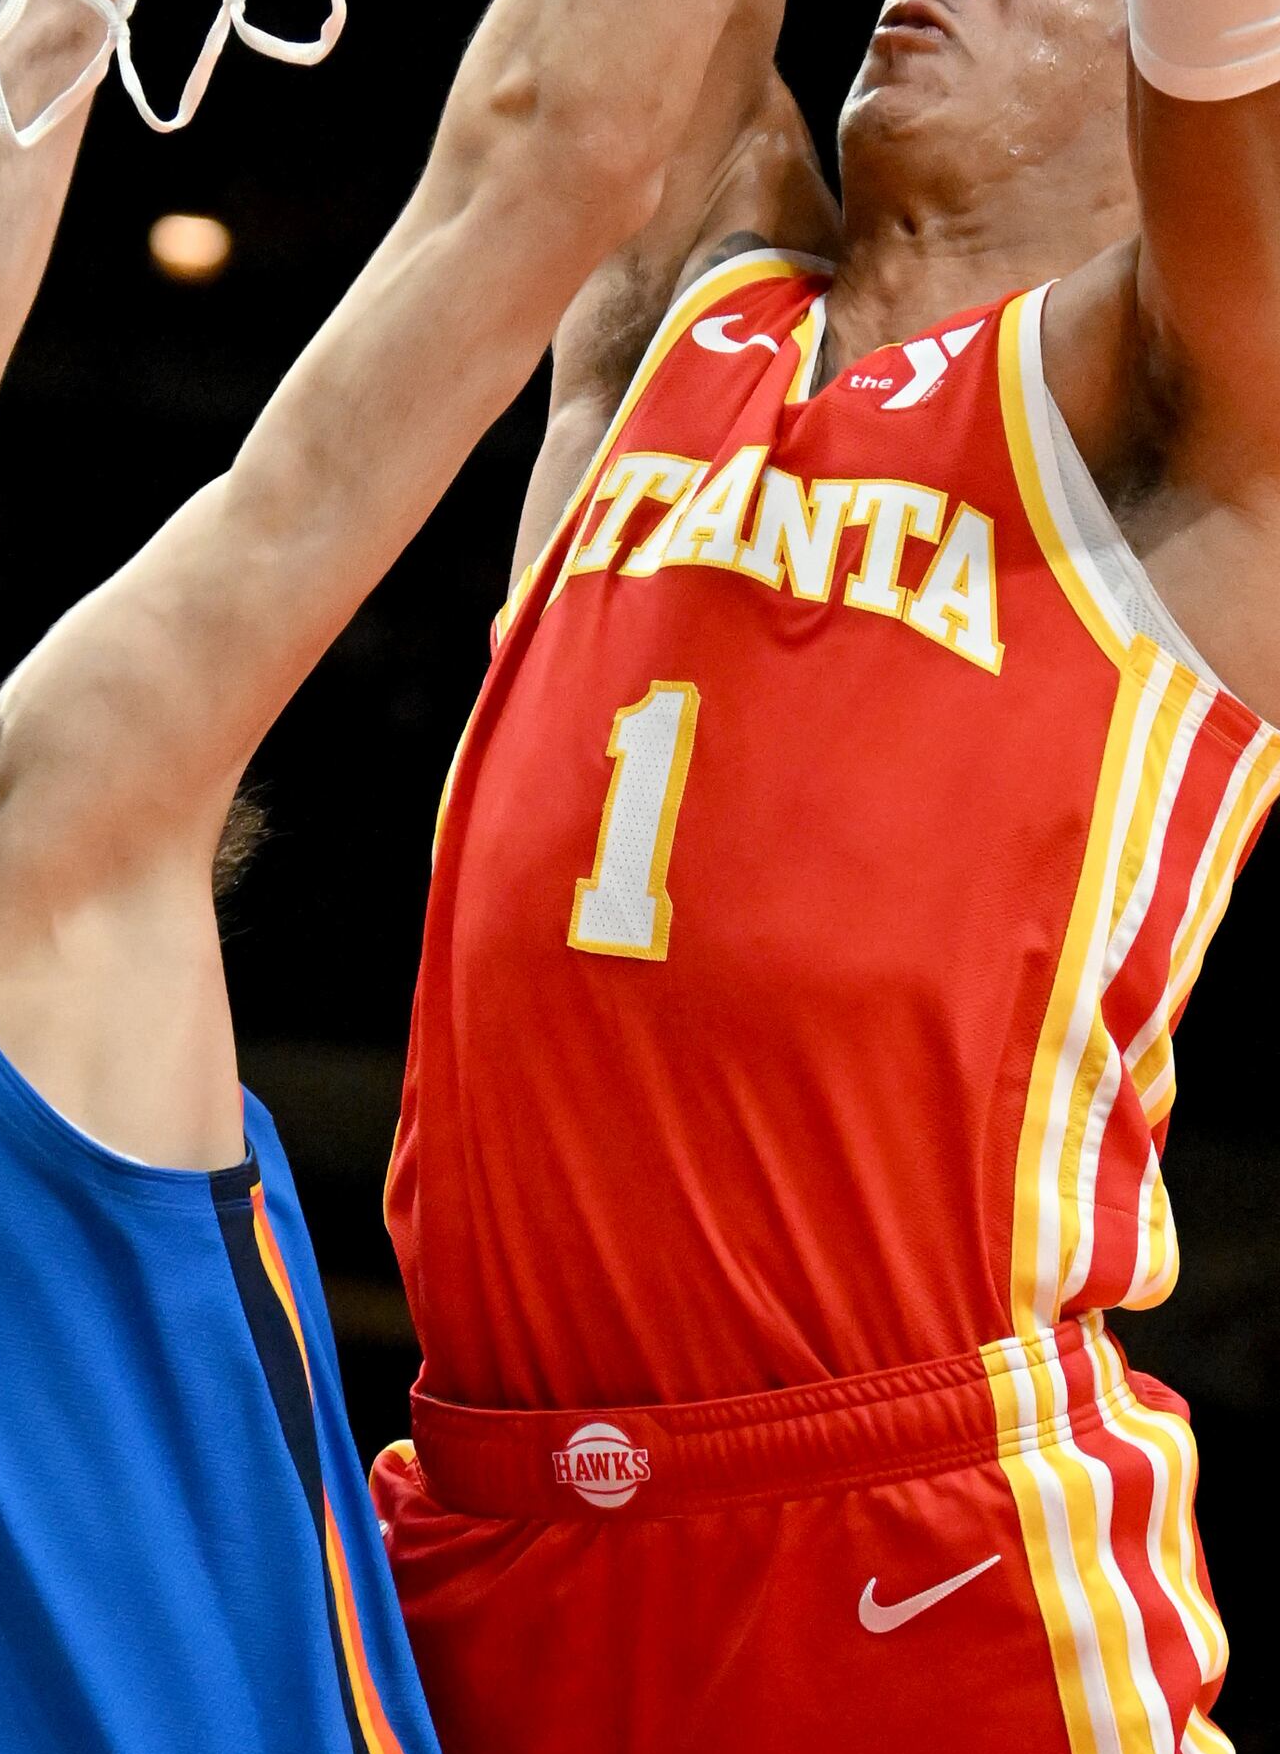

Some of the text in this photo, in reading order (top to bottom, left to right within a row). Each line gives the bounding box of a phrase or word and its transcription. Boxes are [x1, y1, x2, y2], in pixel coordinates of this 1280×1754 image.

[849, 374, 894, 390] the
[566, 680, 702, 962] 1
[552, 1449, 651, 1483] HAWKS
